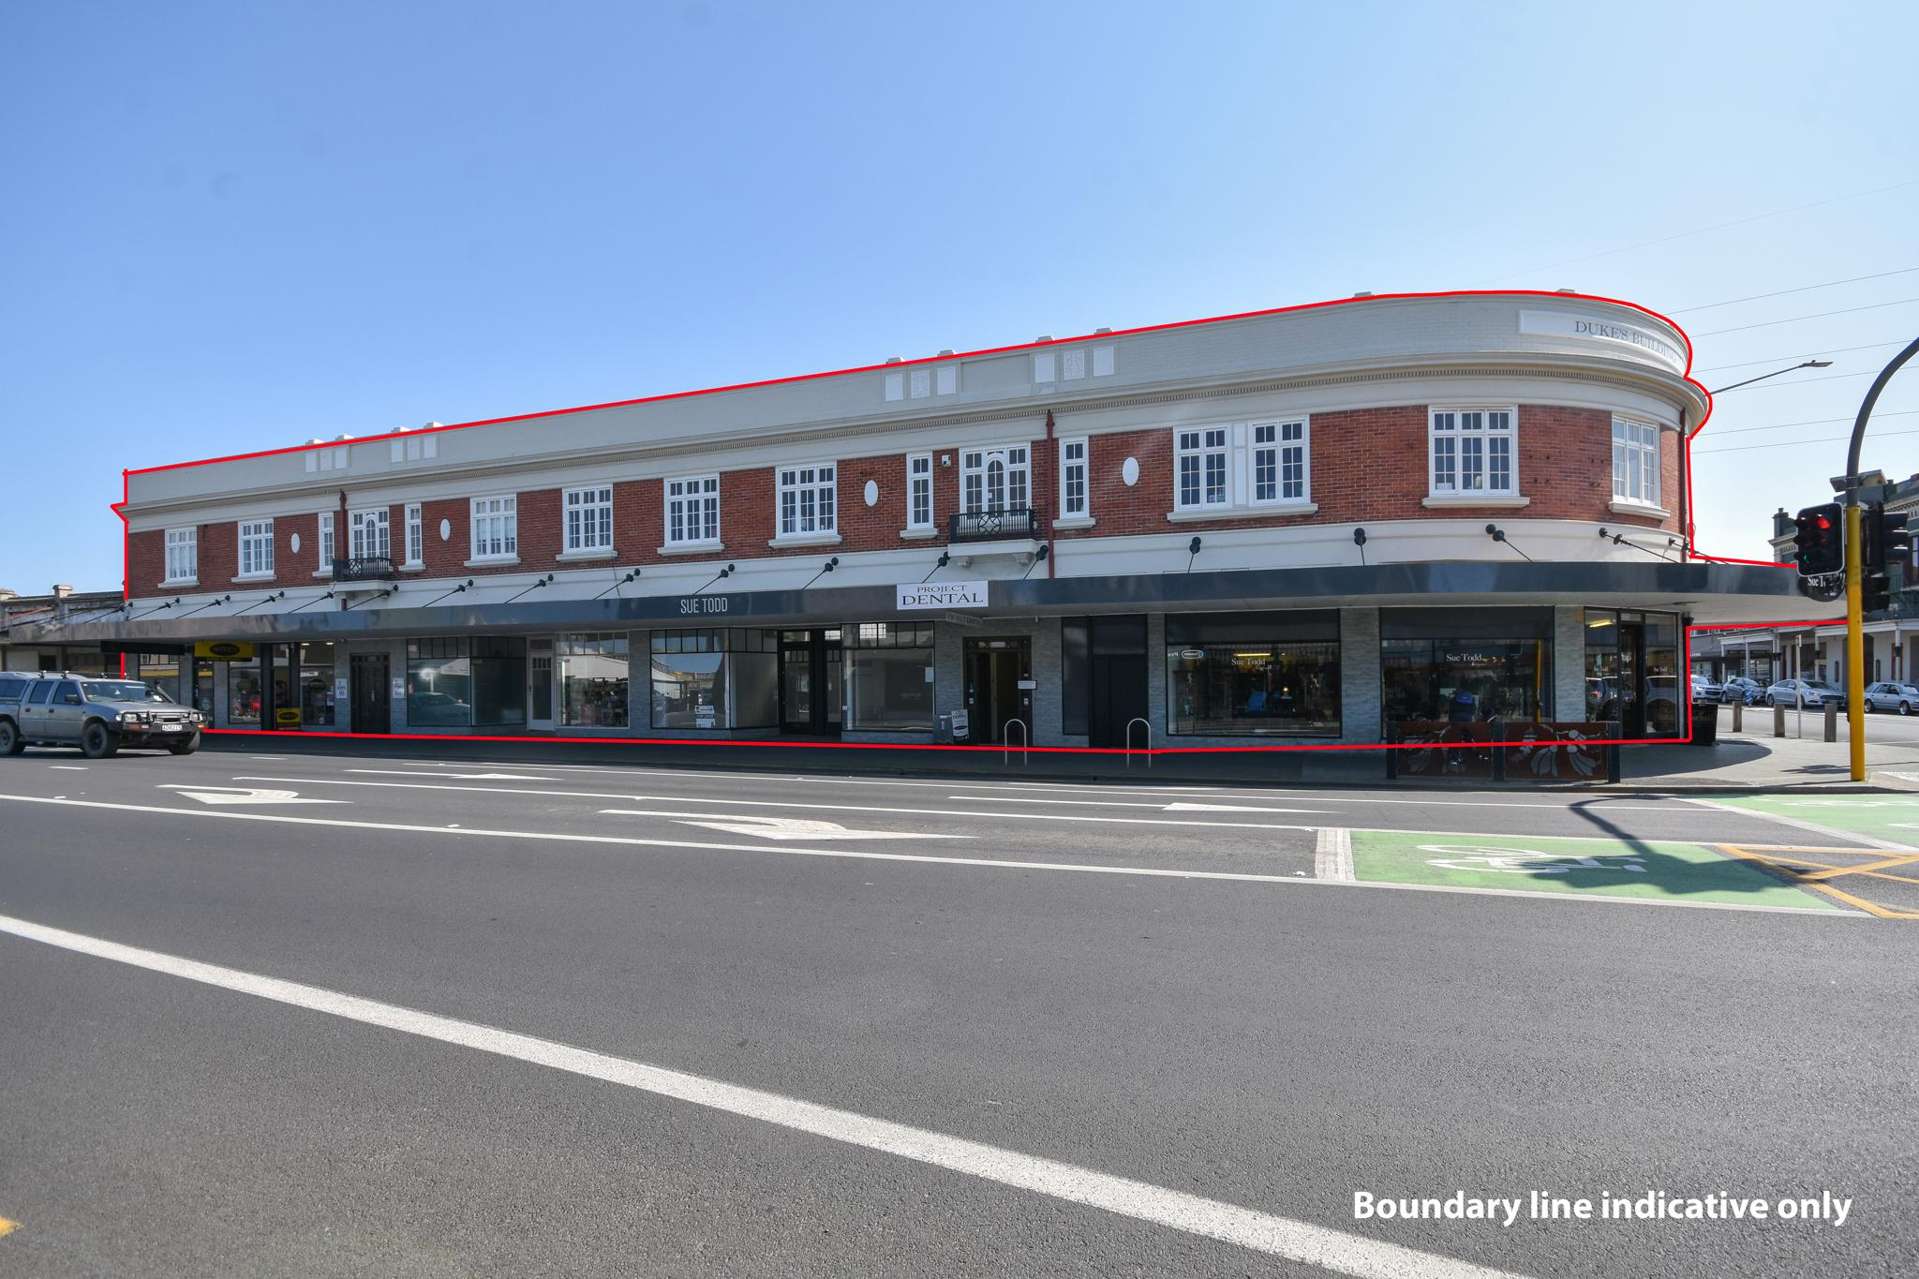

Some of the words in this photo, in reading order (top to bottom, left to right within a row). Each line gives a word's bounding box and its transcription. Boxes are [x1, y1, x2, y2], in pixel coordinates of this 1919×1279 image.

[917, 584, 967, 593] PROJECT
[902, 593, 984, 605] DENTAL
[680, 599, 699, 614] SUE
[702, 597, 728, 613] TODD
